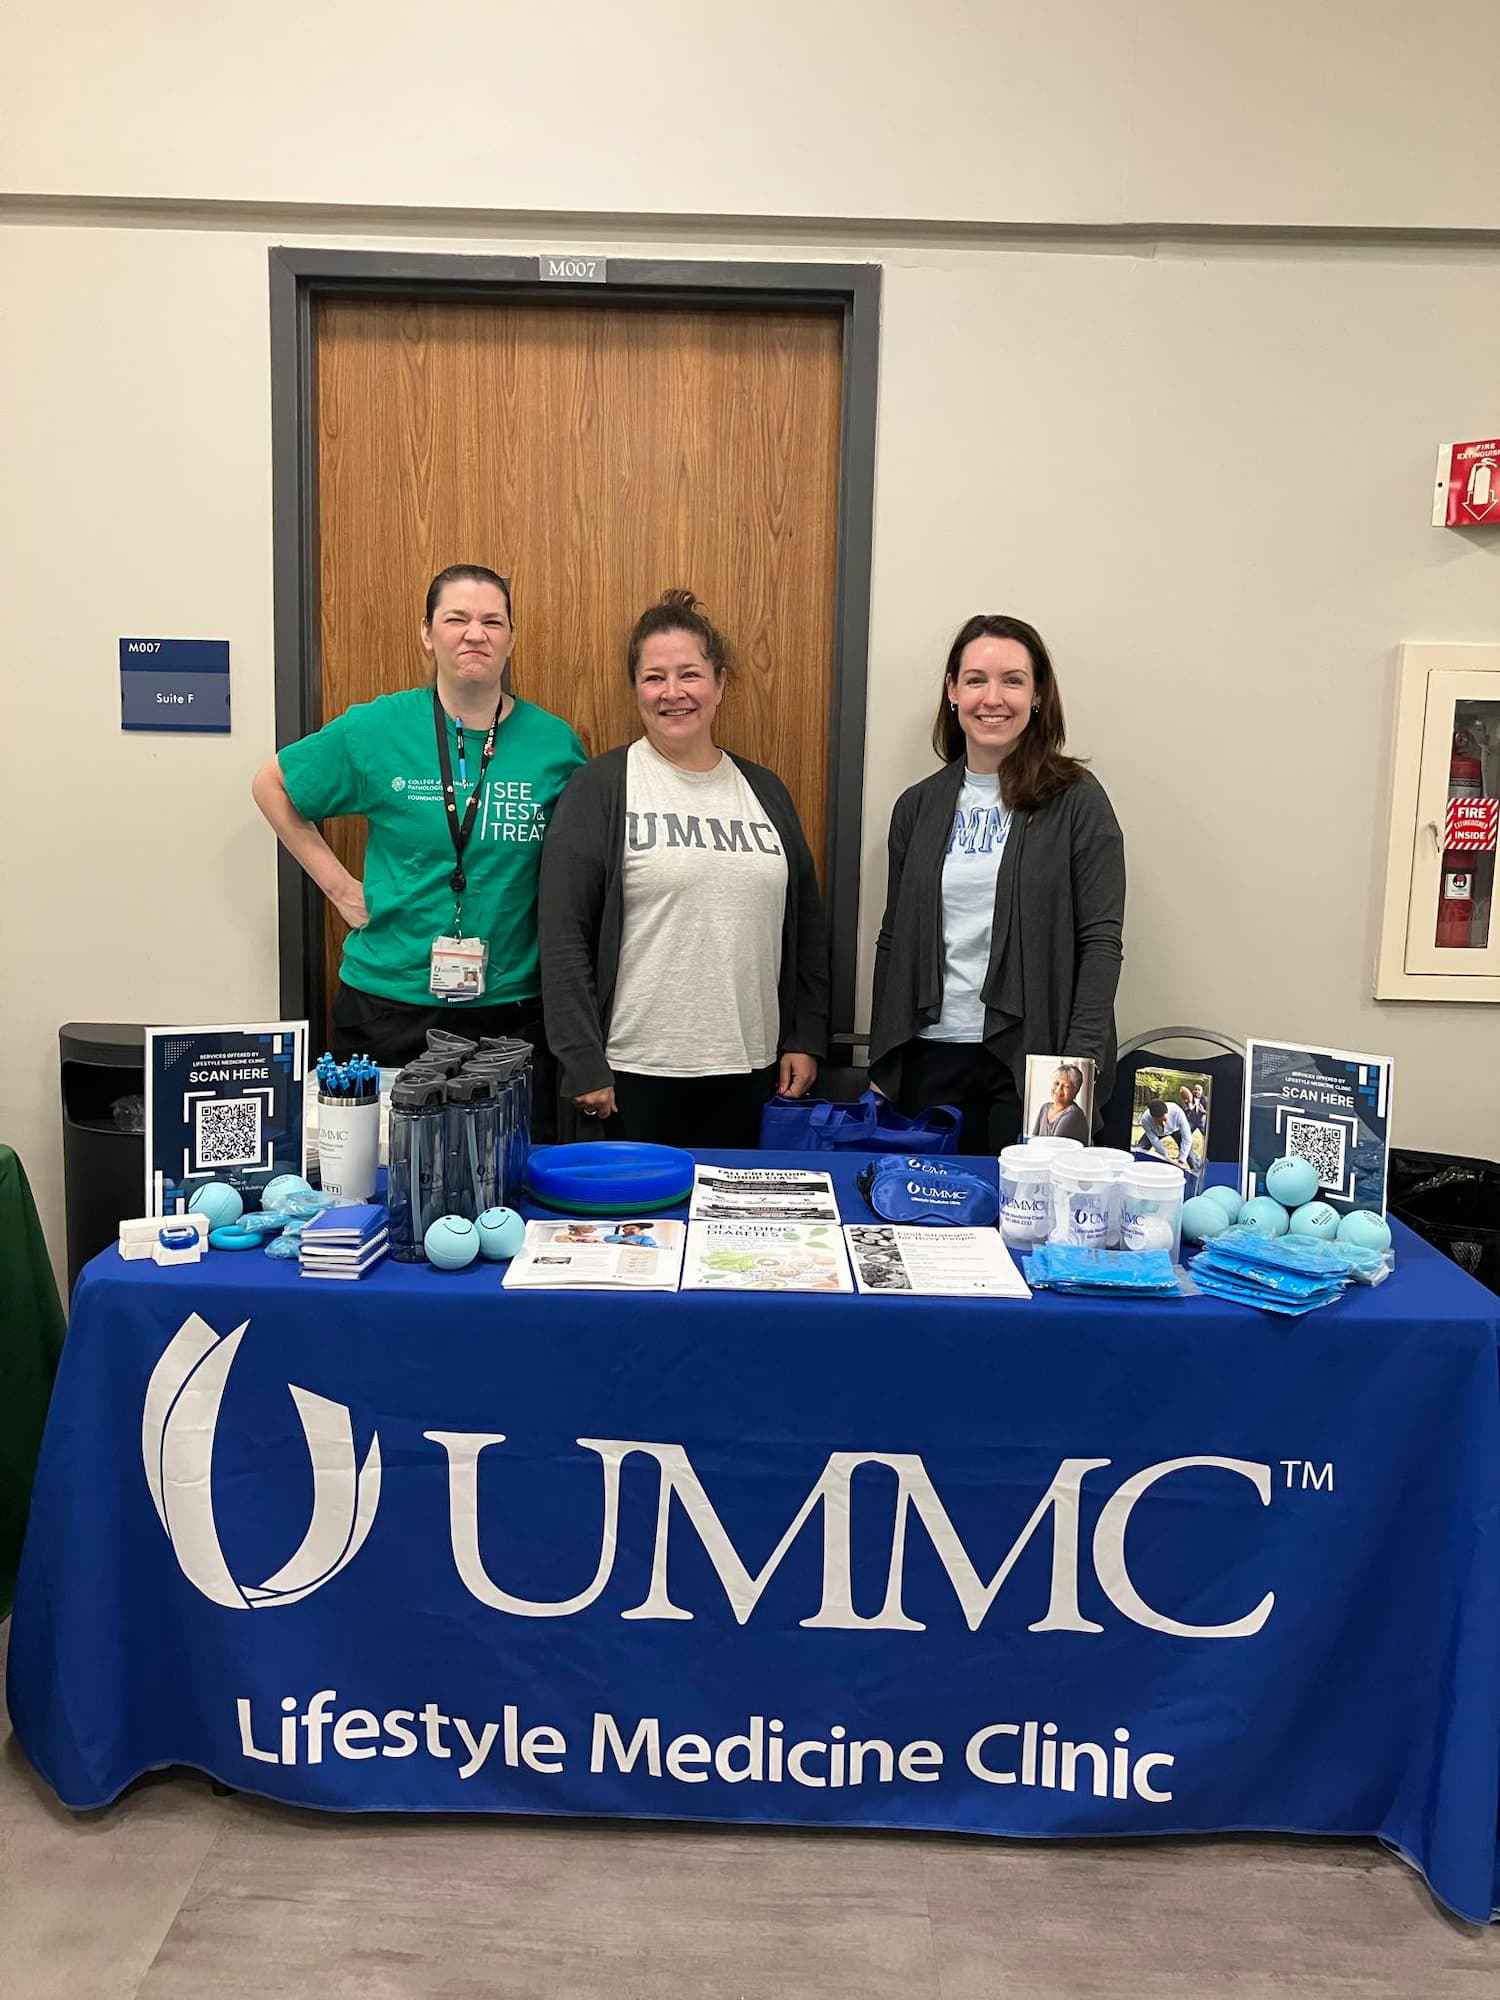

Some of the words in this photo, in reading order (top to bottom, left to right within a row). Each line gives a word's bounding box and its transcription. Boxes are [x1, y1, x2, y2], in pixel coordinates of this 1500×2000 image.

[549, 260, 596, 278] M007
[1476, 442, 1496, 451] FIRE
[128, 642, 161, 653] M007
[156, 692, 184, 704] Suite
[187, 693, 195, 704] F
[494, 782, 532, 801] SEE
[493, 802, 539, 821] TEST
[1457, 806, 1488, 819] FIRE
[491, 823, 546, 842] TREAT
[626, 811, 782, 856] UMMC
[945, 805, 1015, 855] MM
[1454, 831, 1487, 840] INSIDE
[189, 1069, 230, 1083] SCAN
[232, 1067, 270, 1081] HERE
[1282, 1086, 1318, 1102] SCAN
[1320, 1091, 1355, 1108] HERE
[922, 1186, 969, 1200] UMMC
[707, 1224, 795, 1232] DECODING
[707, 1230, 779, 1238] DIABETES
[423, 1429, 1275, 1638] UMMC
[1279, 1460, 1334, 1492] TM
[236, 1689, 567, 1780] Lifestyle
[589, 1712, 943, 1788] Medicine
[965, 1720, 1175, 1803] Clinic
